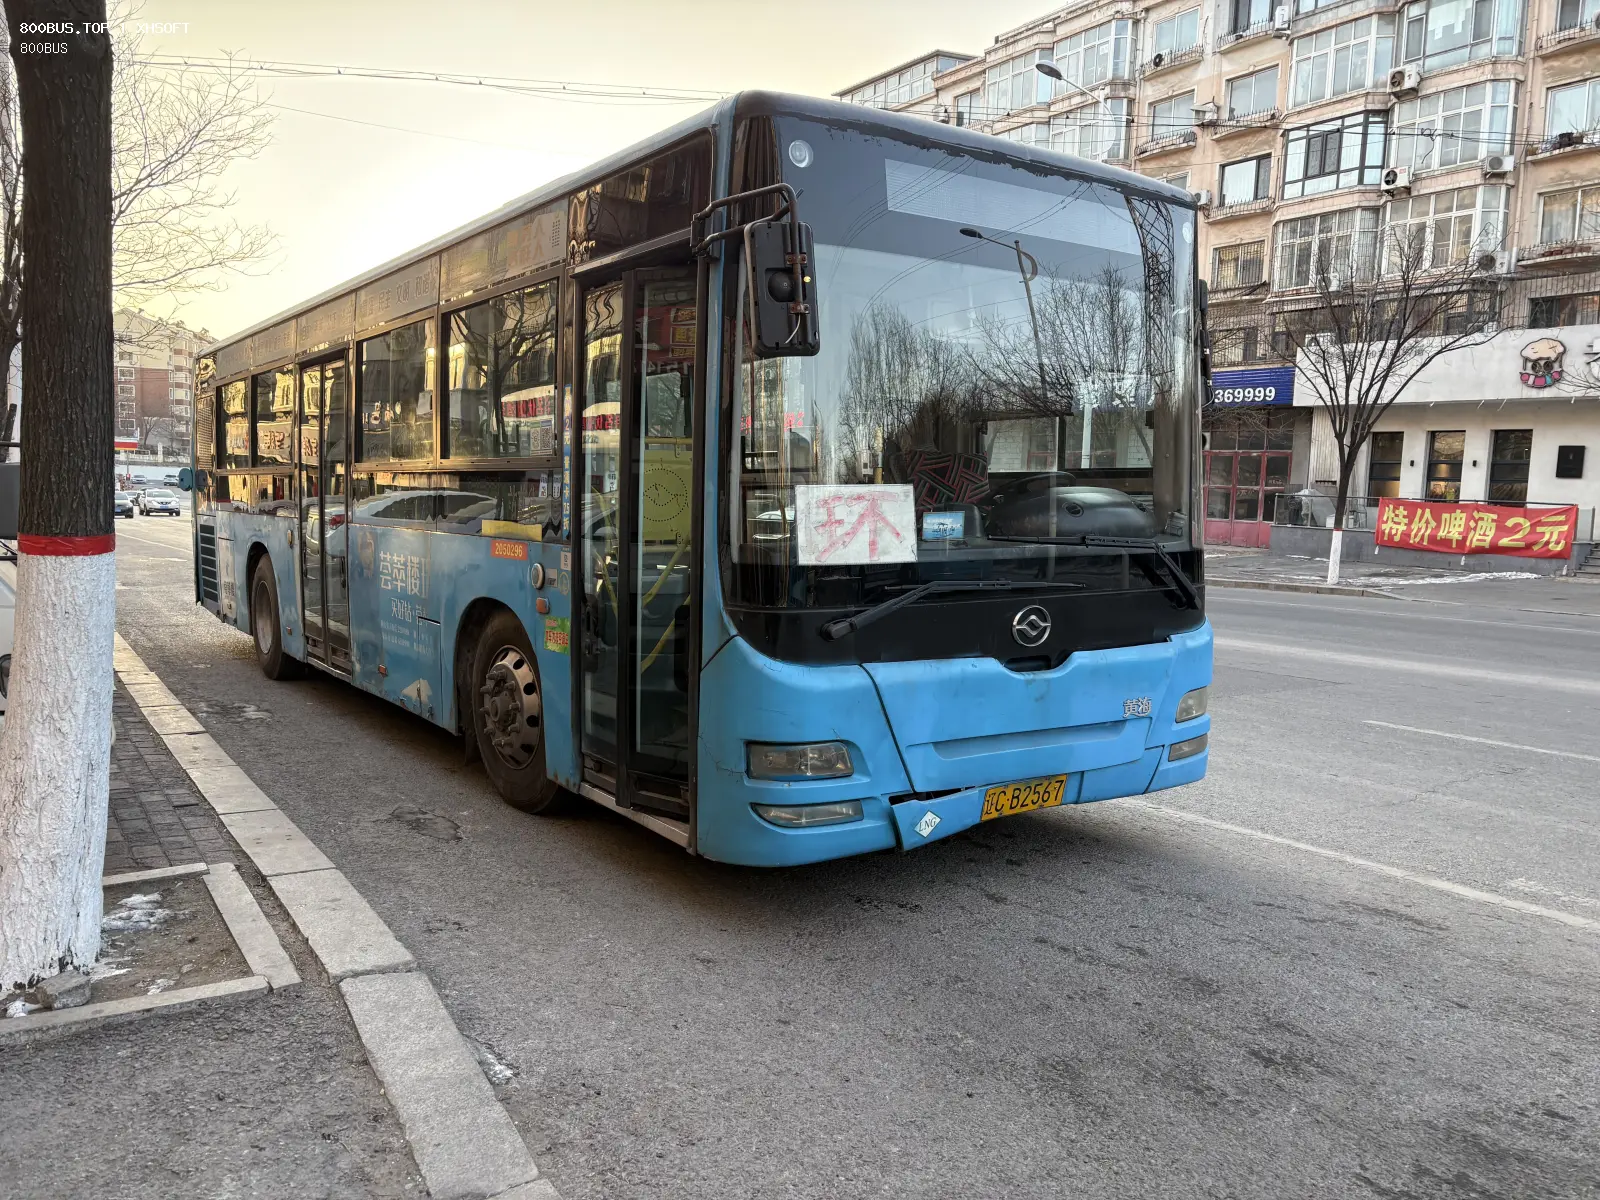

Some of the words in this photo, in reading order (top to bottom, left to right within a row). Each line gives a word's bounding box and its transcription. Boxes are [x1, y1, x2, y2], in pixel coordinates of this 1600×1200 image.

[1214, 386, 1276, 403] 369999
[1382, 504, 1568, 551] 特价啤酒2元
[495, 542, 523, 557] 2050296
[1122, 696, 1153, 718] 黄海
[918, 816, 937, 833] LNG
